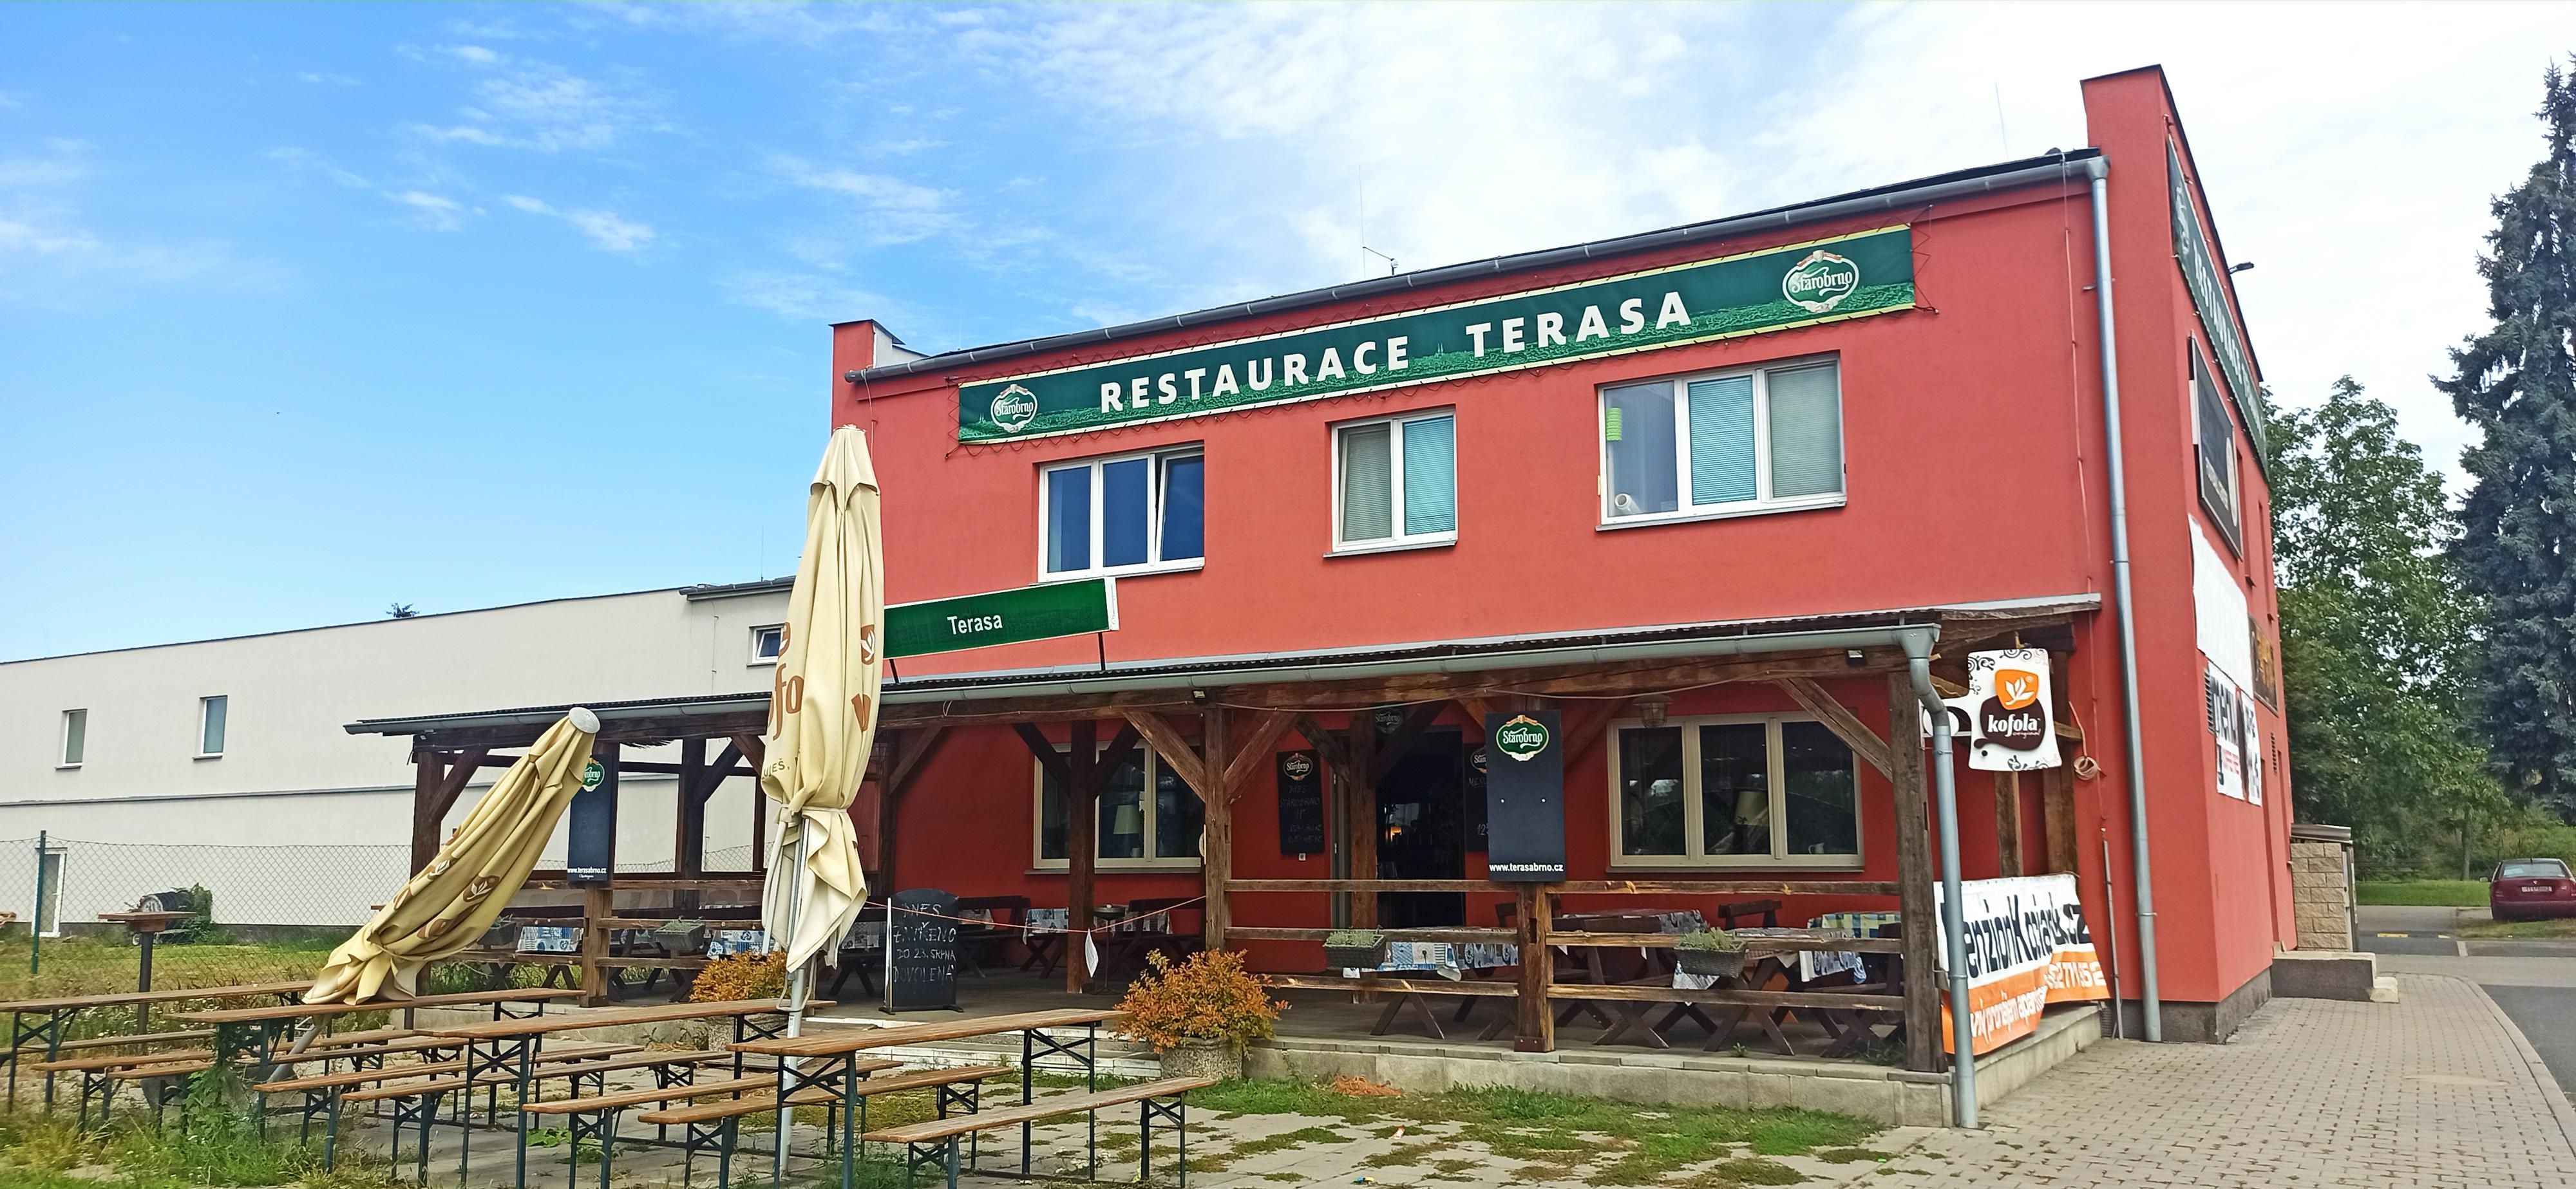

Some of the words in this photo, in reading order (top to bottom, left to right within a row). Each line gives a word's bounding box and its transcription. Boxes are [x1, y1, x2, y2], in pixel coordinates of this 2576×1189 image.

[1792, 267, 1853, 296] Starobrno
[1101, 335, 1408, 413] RESTAURACE
[1466, 292, 1691, 357] TERASA
[994, 397, 1034, 420] Starobrno
[947, 614, 1003, 635] Terasa
[1987, 713, 2038, 737] kofola
[1502, 727, 1543, 749] Starobrno
[1287, 760, 1309, 772] Starobrno
[1489, 863, 1564, 872] www.terasabrno.cz
